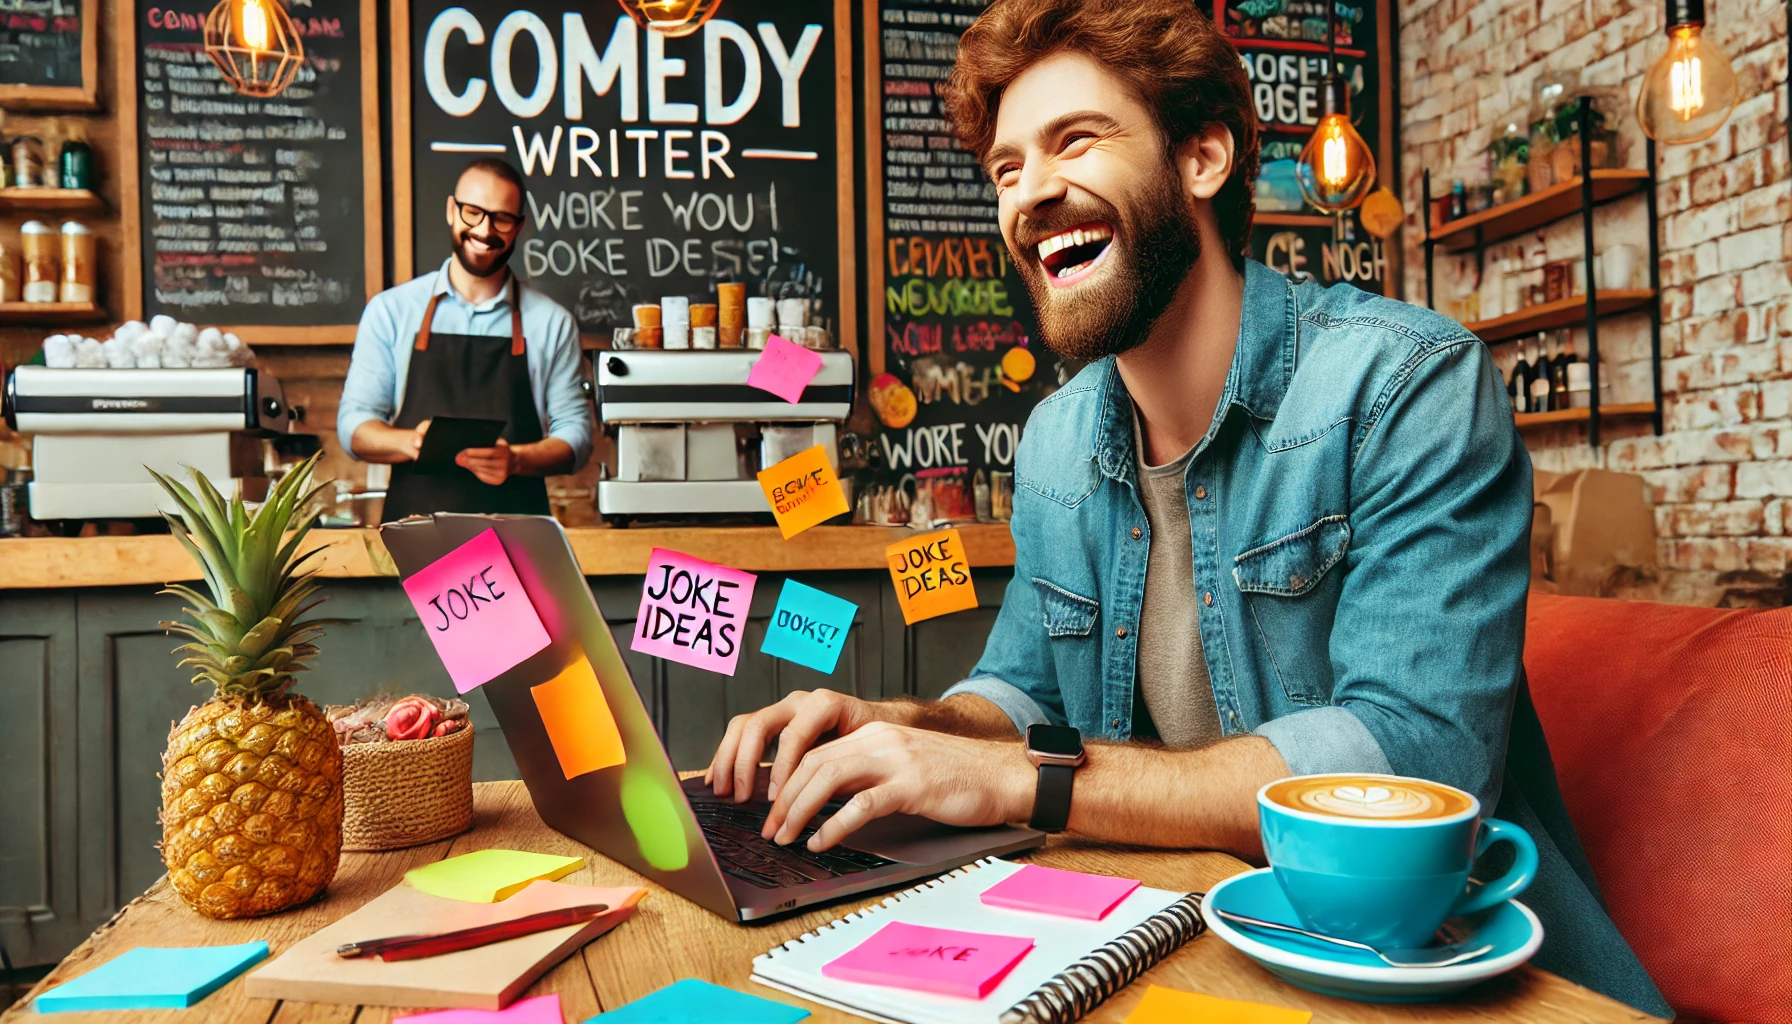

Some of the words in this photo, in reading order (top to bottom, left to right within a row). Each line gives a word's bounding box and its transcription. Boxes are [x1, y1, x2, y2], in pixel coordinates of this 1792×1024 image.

[423, 6, 824, 128] COMEDY
[512, 125, 736, 180] WRITER
[880, 423, 969, 471] WORE
[894, 536, 954, 574] JOKE
[428, 565, 506, 632] JOKE
[647, 564, 740, 619] JOKE
[641, 604, 736, 658] IDEAS
